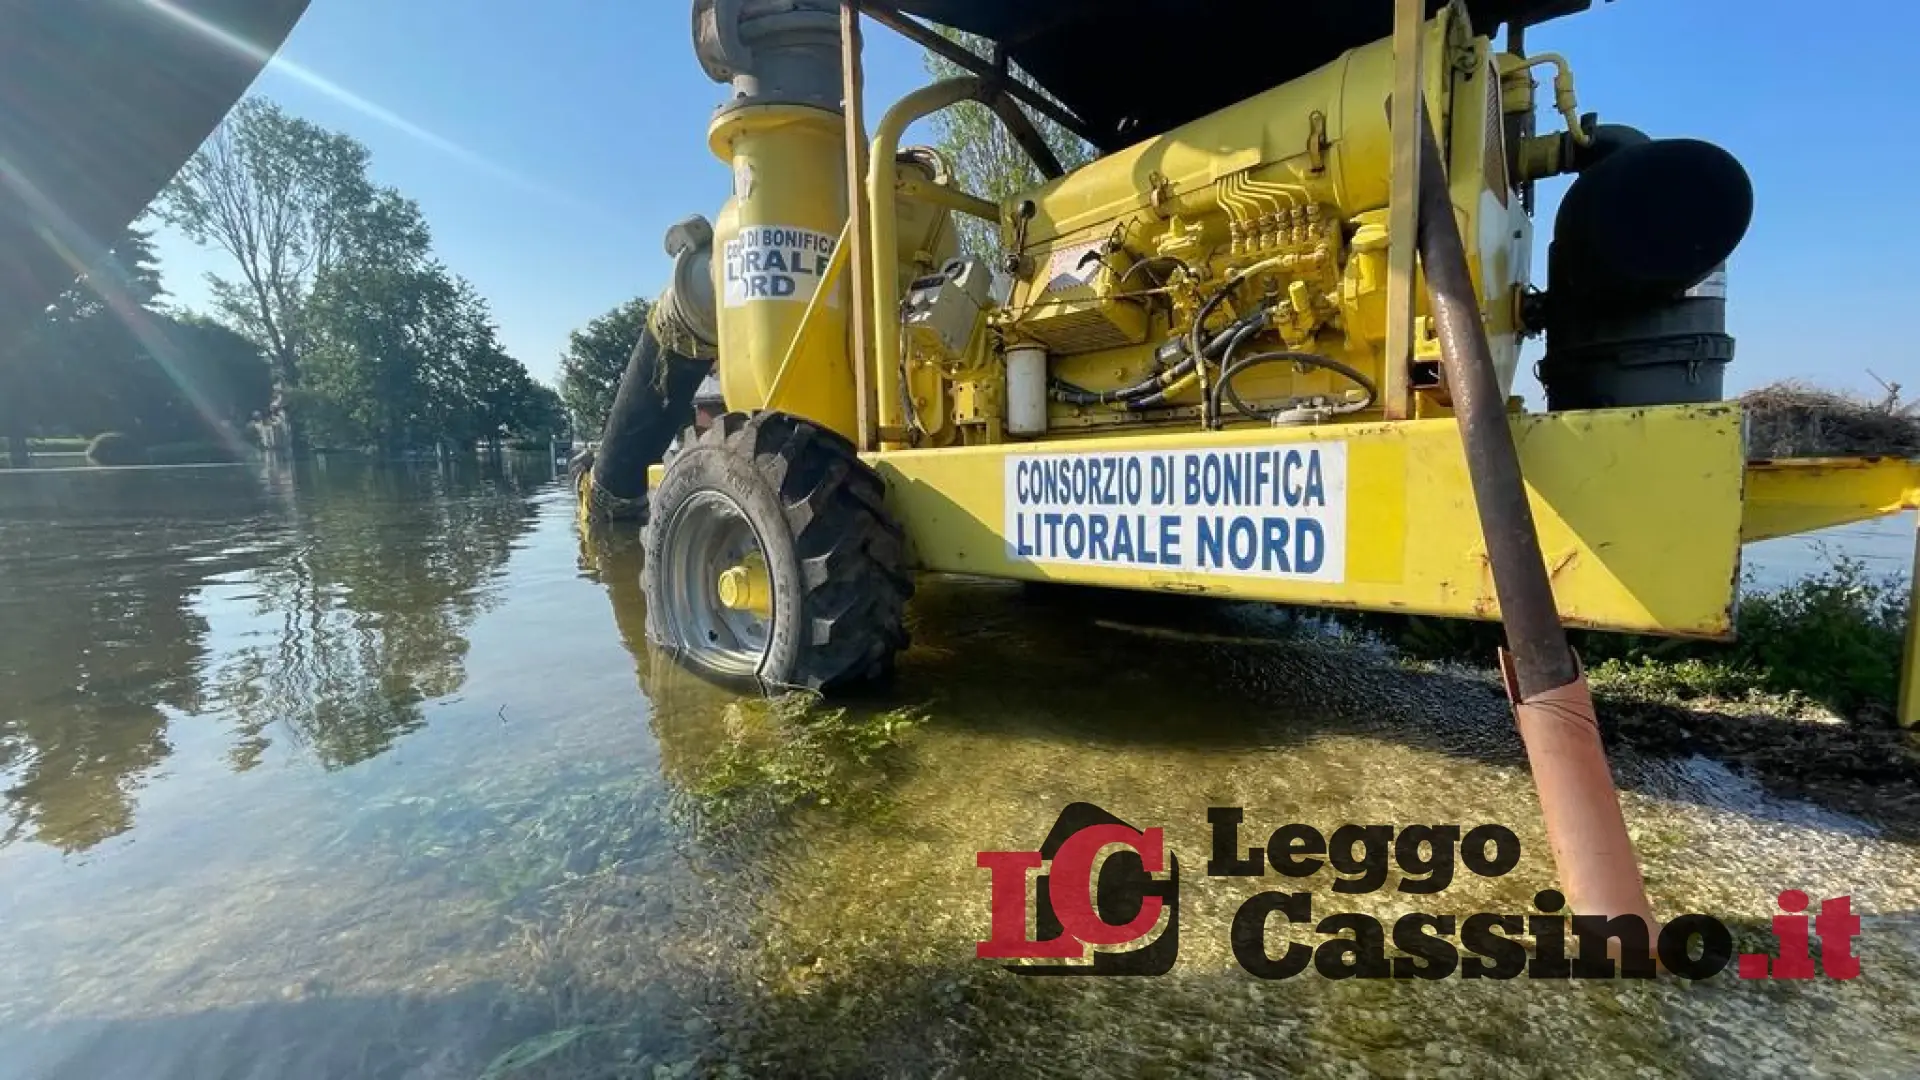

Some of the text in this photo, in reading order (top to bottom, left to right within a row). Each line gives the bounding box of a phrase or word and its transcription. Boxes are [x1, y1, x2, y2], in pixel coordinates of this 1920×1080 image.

[747, 230, 758, 247] DI
[1017, 450, 1325, 507] CONSORZIO DI BONIFICA
[1017, 513, 1325, 574] LITORALE NORD
